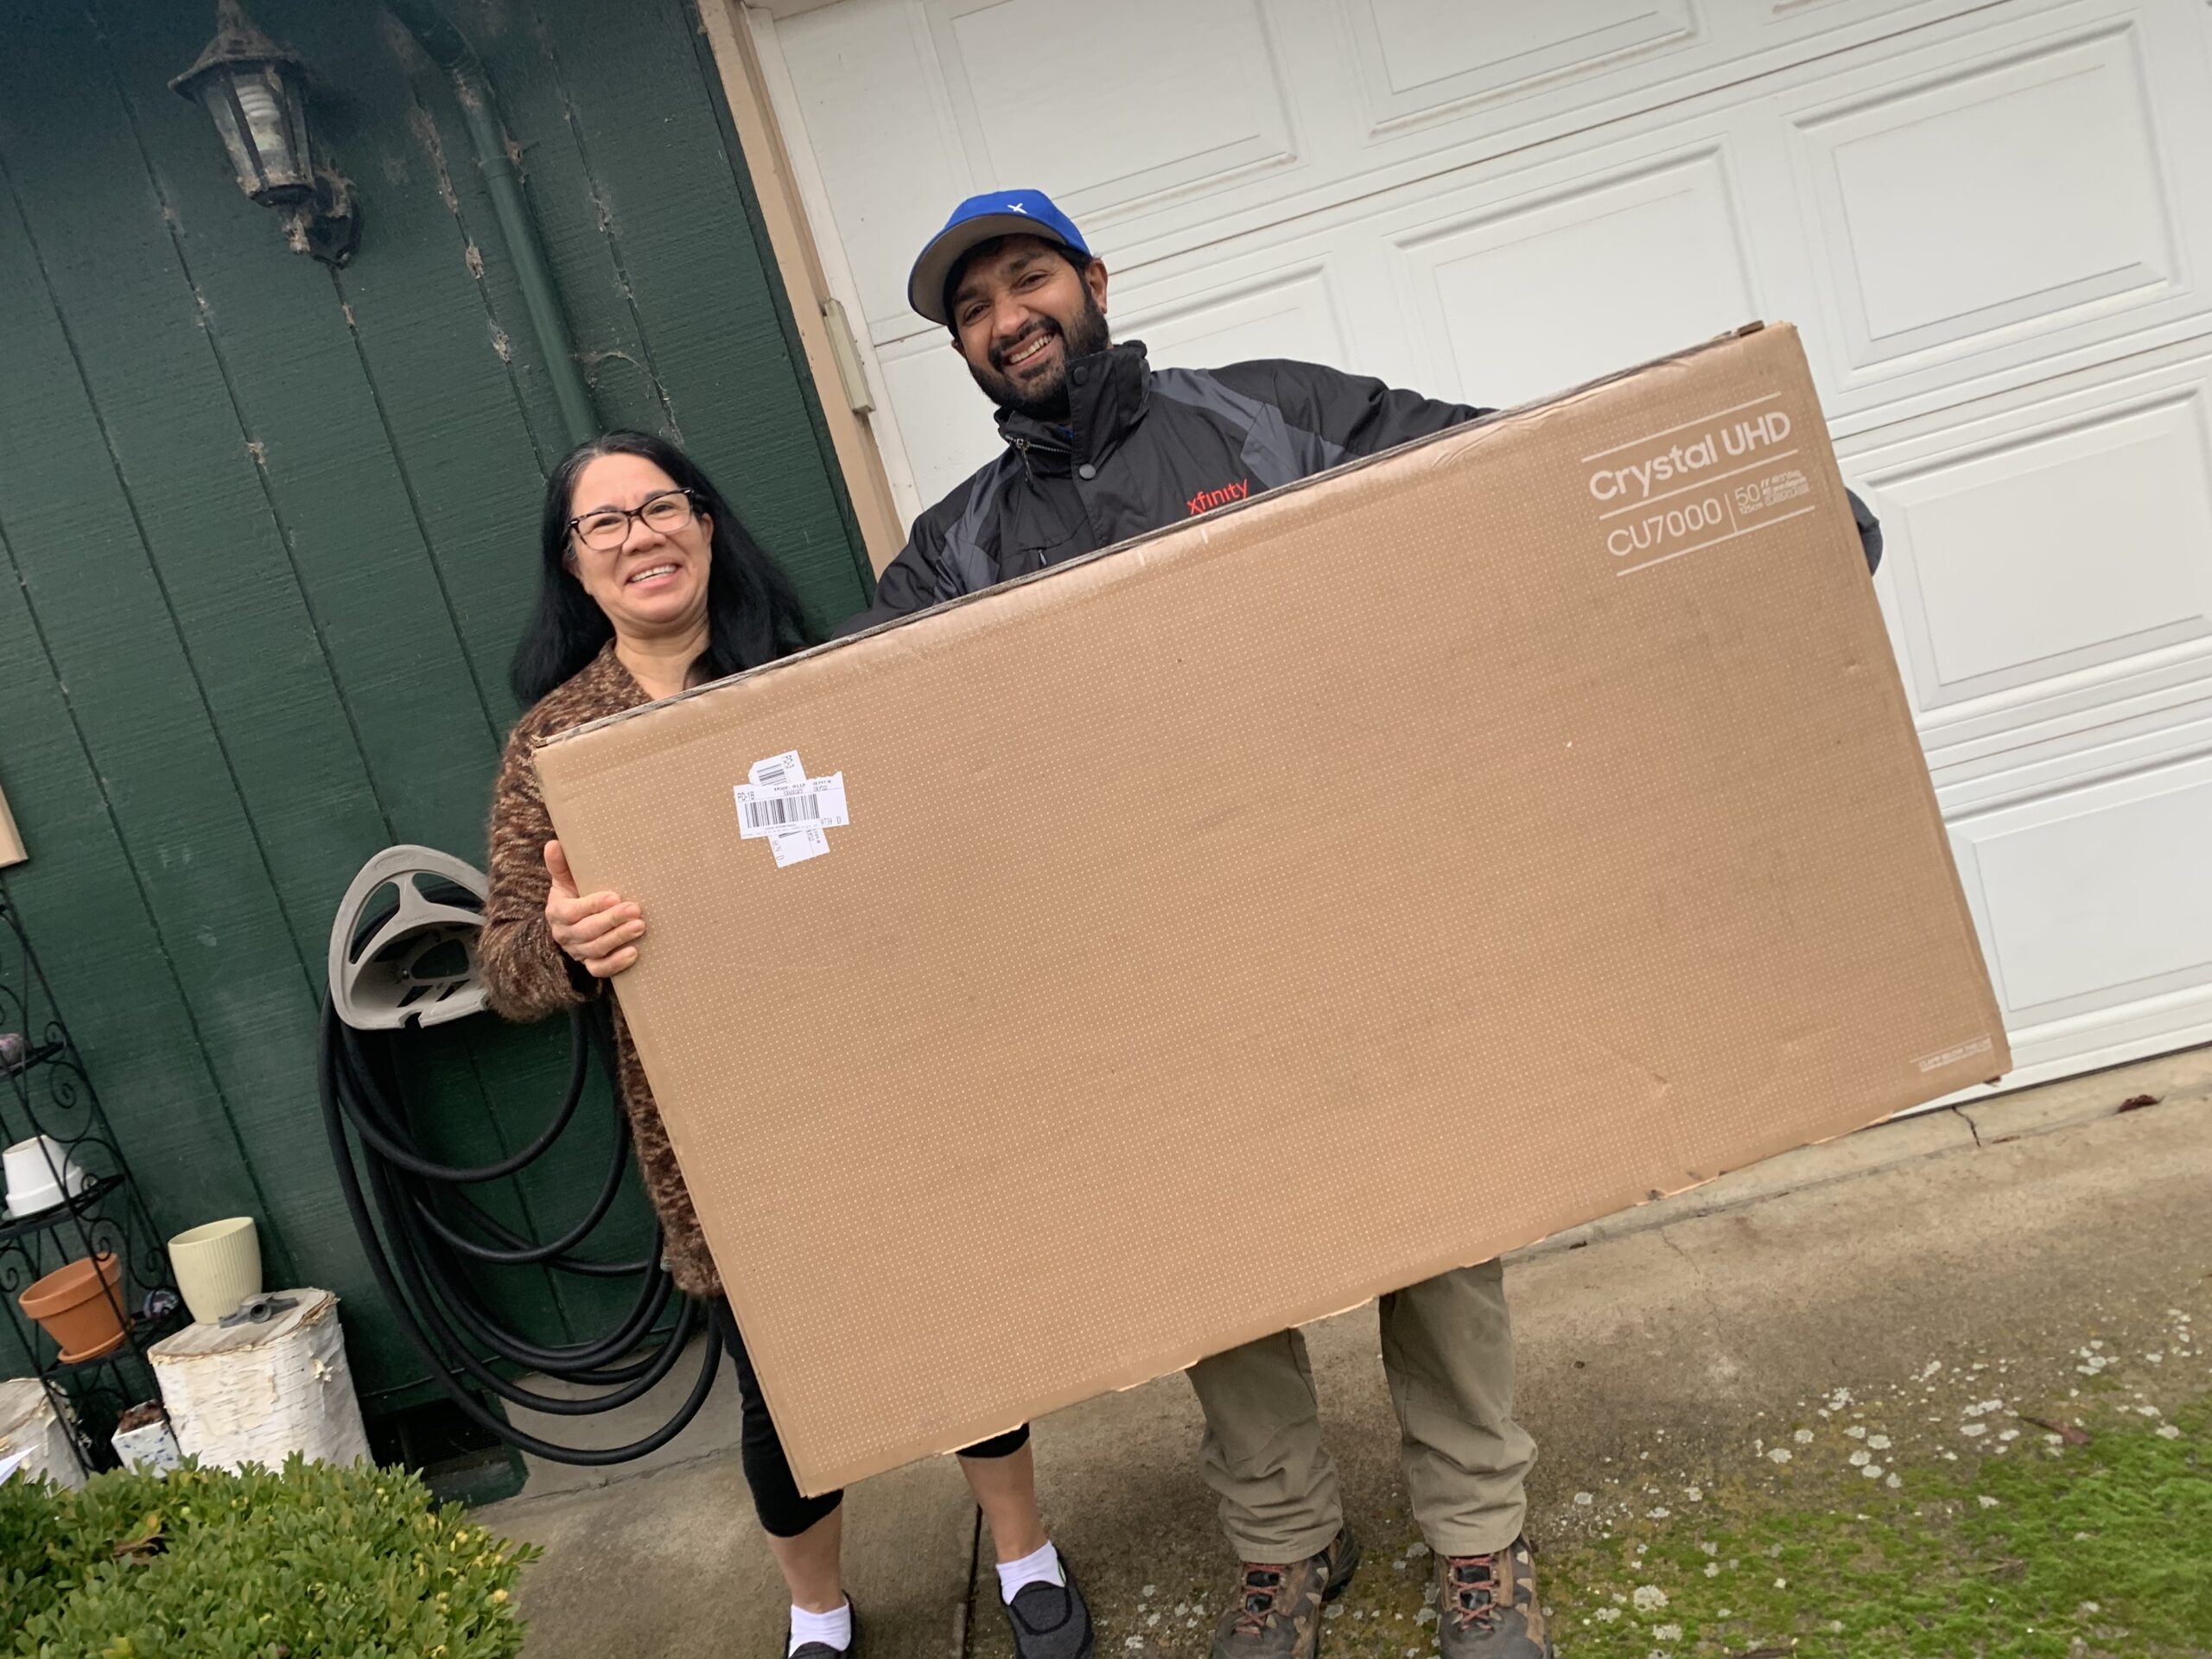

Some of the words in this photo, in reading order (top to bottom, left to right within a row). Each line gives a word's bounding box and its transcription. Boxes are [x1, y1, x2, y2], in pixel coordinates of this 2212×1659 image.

[1590, 434, 1719, 501] Crystal
[1720, 411, 1791, 456] UHD
[1186, 478, 1248, 515] xfinity
[1607, 498, 1723, 556] CU7000
